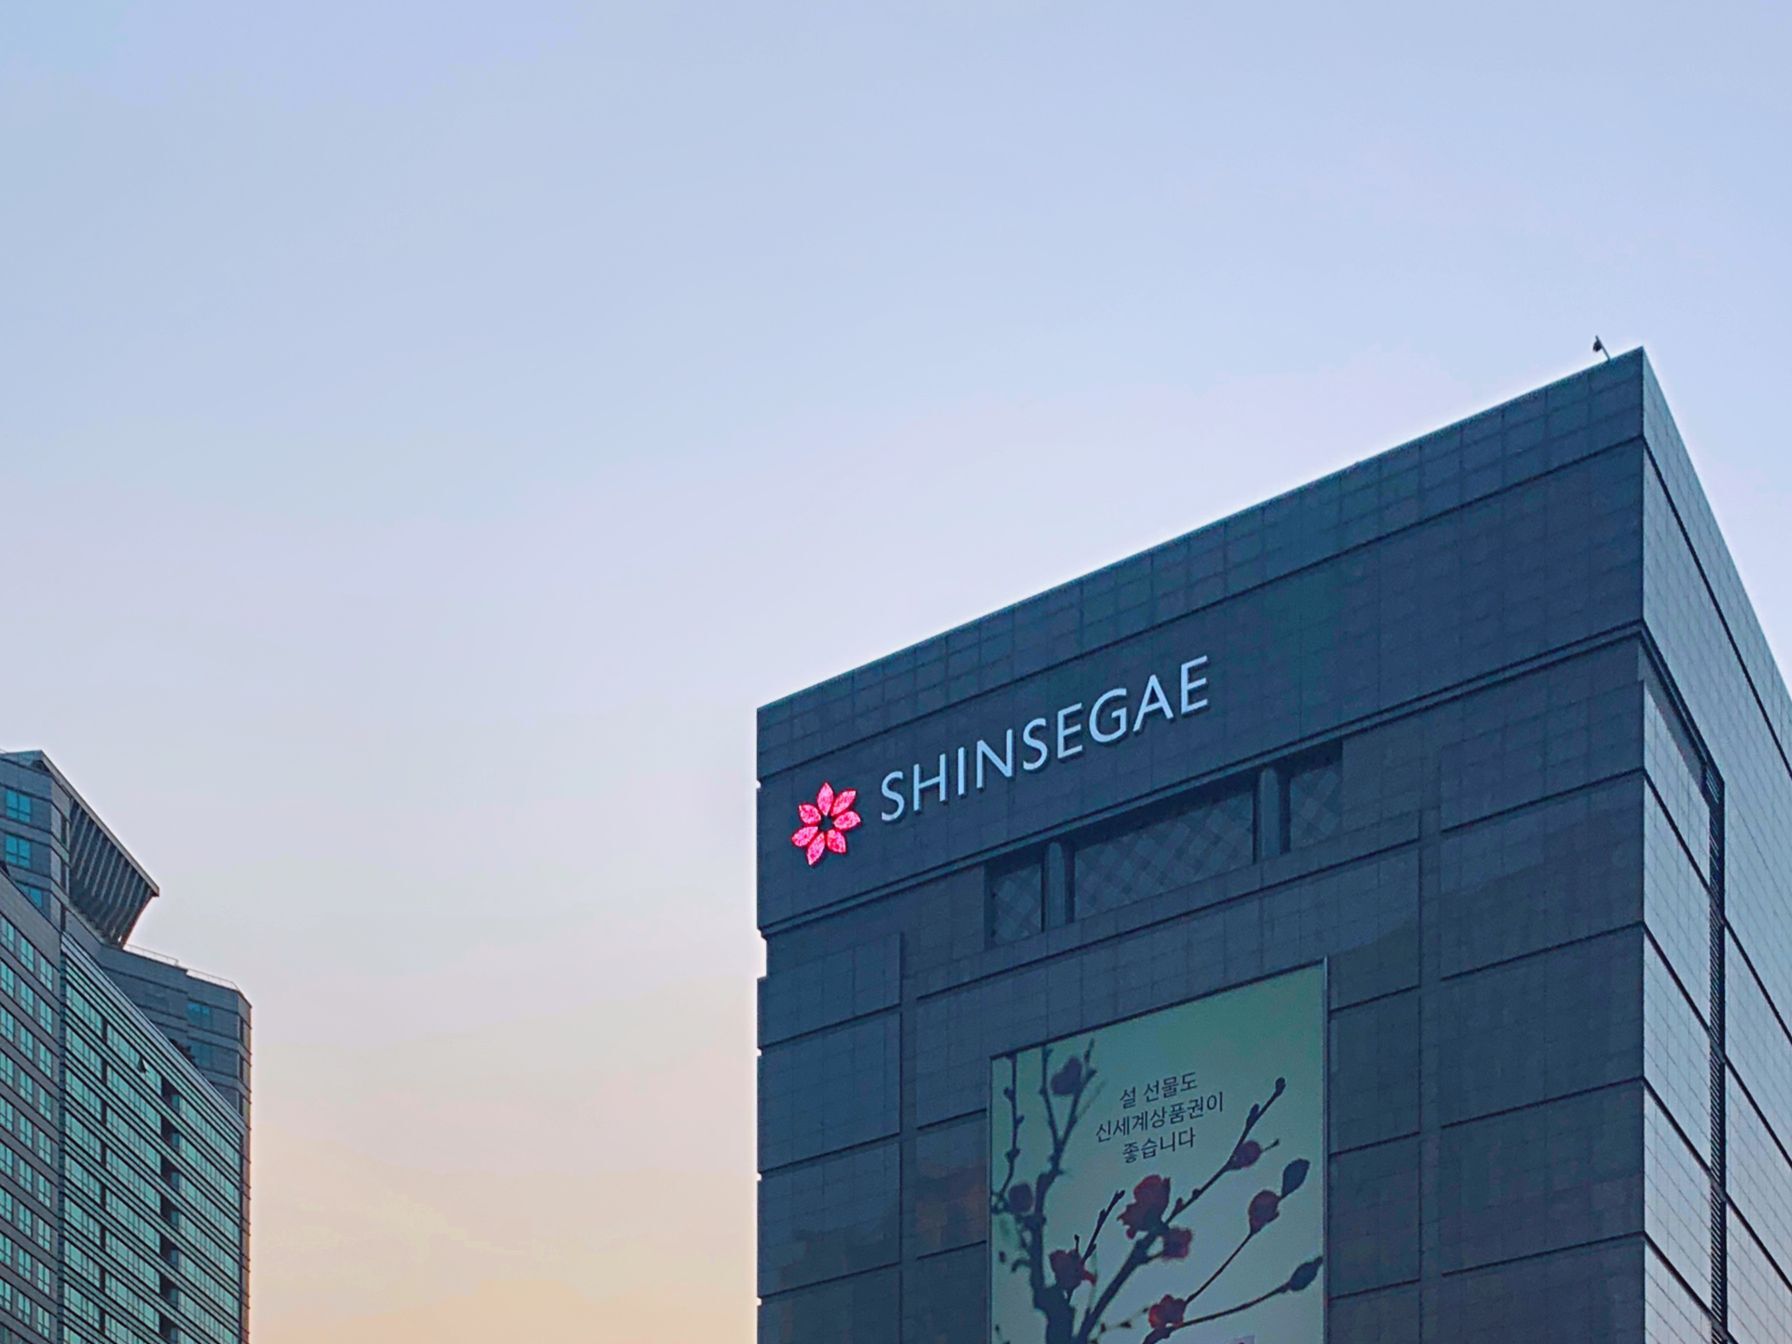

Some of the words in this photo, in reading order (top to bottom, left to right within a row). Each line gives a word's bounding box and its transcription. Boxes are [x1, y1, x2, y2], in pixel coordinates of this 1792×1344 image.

[881, 655, 1209, 822] SHINSEGAE
[1120, 1086, 1137, 1110] 설
[1143, 1071, 1198, 1103] 선물도
[1095, 1091, 1223, 1143] 신세계상품권이
[1122, 1126, 1196, 1164] 좋습니다
